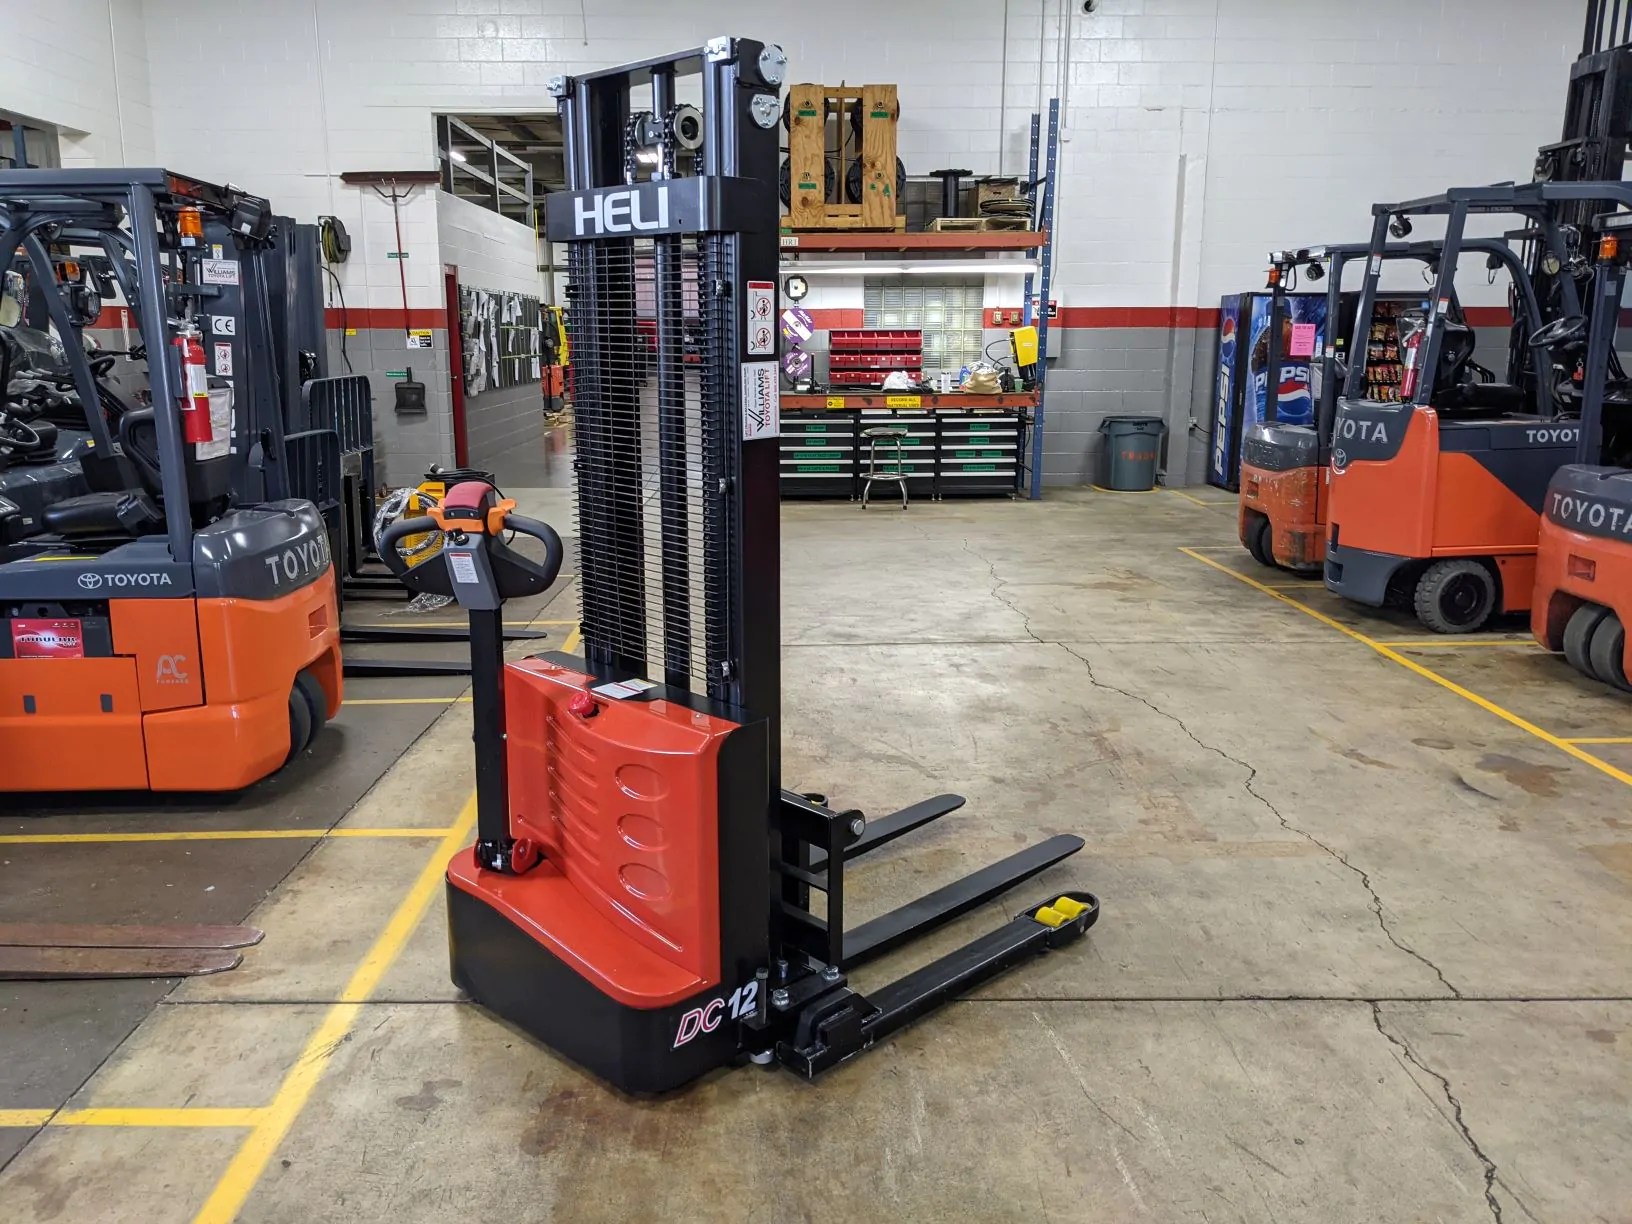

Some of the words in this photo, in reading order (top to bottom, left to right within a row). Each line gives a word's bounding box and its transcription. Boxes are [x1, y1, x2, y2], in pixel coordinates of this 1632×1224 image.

[574, 186, 669, 235] HELI
[214, 318, 233, 333] CE
[747, 367, 765, 433] WILLIAMS
[1214, 364, 1230, 476] PEPSI
[1335, 416, 1388, 443] YOTA
[1526, 428, 1580, 444] TOYOT
[104, 573, 172, 587] TOYOTA
[156, 654, 188, 679] AC
